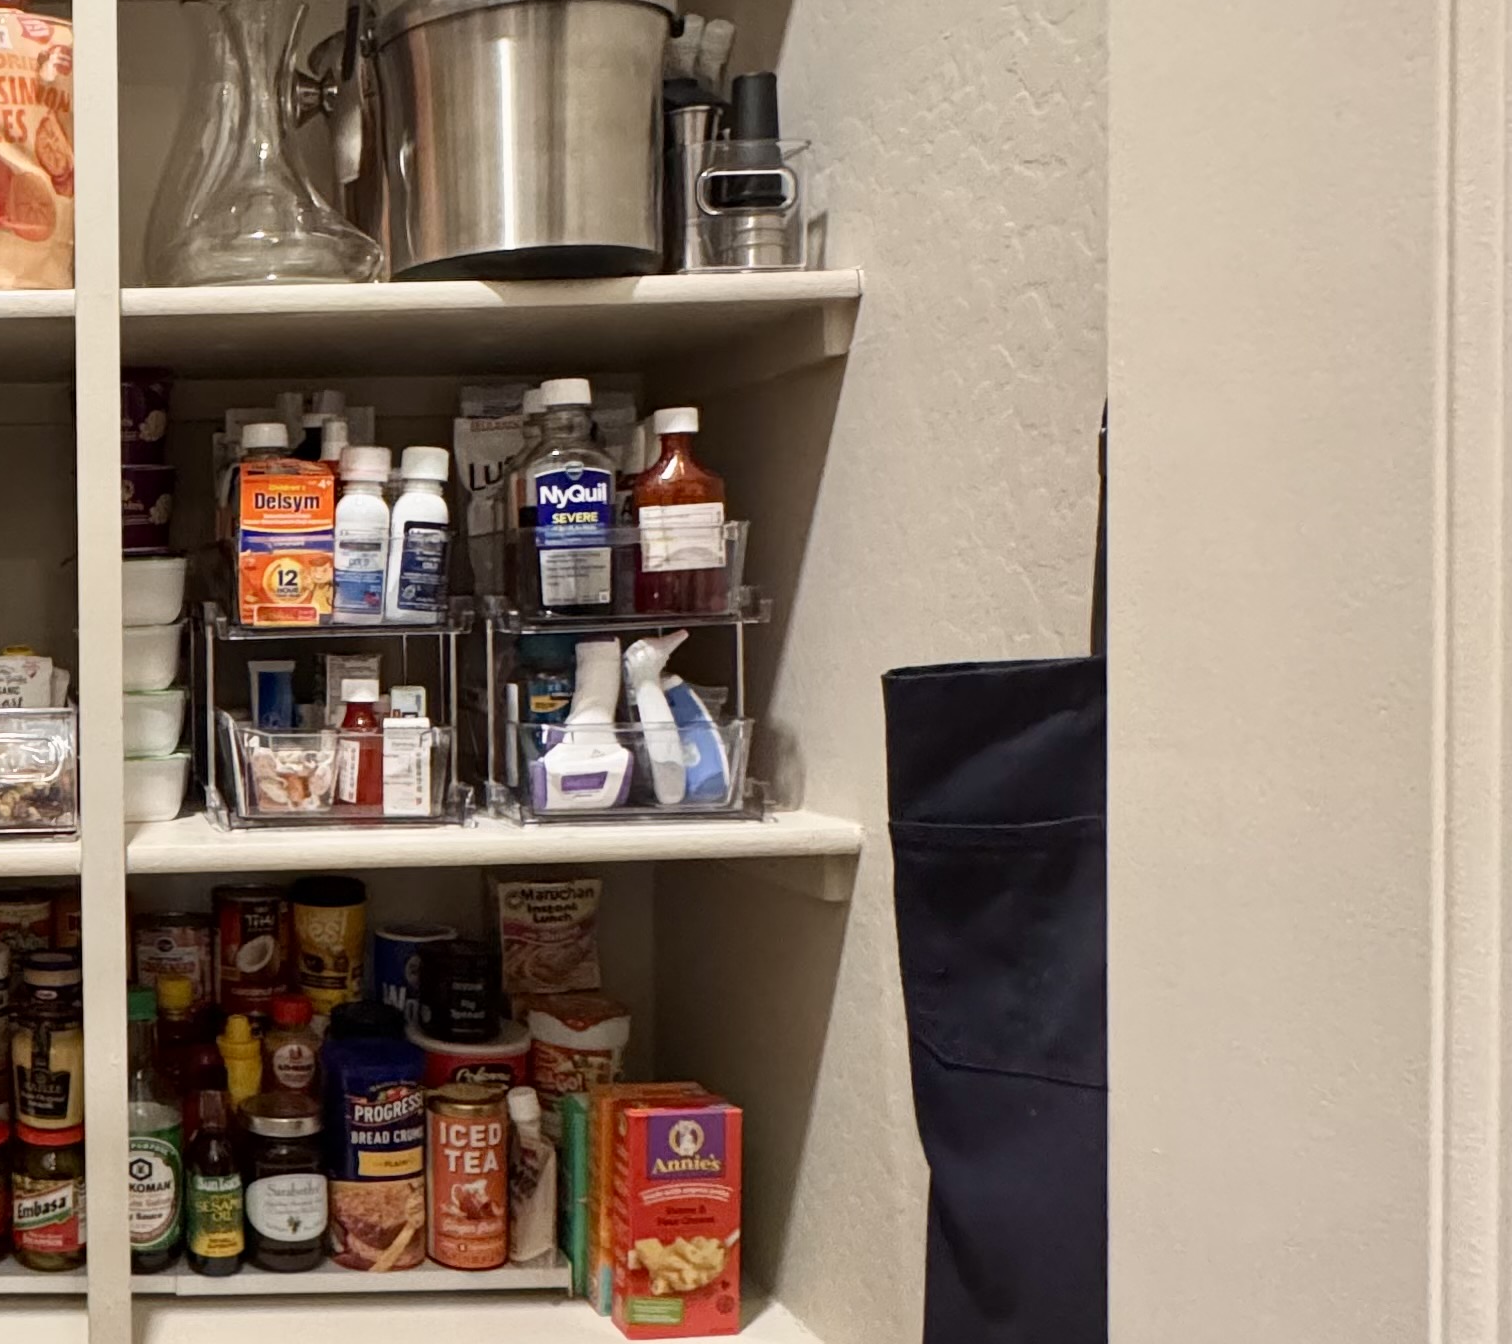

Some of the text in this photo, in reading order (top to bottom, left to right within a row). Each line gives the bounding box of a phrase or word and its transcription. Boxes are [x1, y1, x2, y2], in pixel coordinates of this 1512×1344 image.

[254, 492, 320, 512] Delsym
[540, 482, 608, 509] NyQuil
[551, 512, 599, 524] SEVERE
[277, 570, 299, 587] 12
[521, 888, 594, 901] Maruchan
[533, 913, 572, 923] Lunch
[354, 1089, 424, 1124] PROGRESS
[351, 1130, 390, 1145] BREAD
[439, 1122, 503, 1148] ICED
[444, 1148, 499, 1175] TEA
[652, 1154, 721, 1174] Annie's
[129, 1181, 171, 1193] KOMAN
[17, 1197, 67, 1219] Embasa
